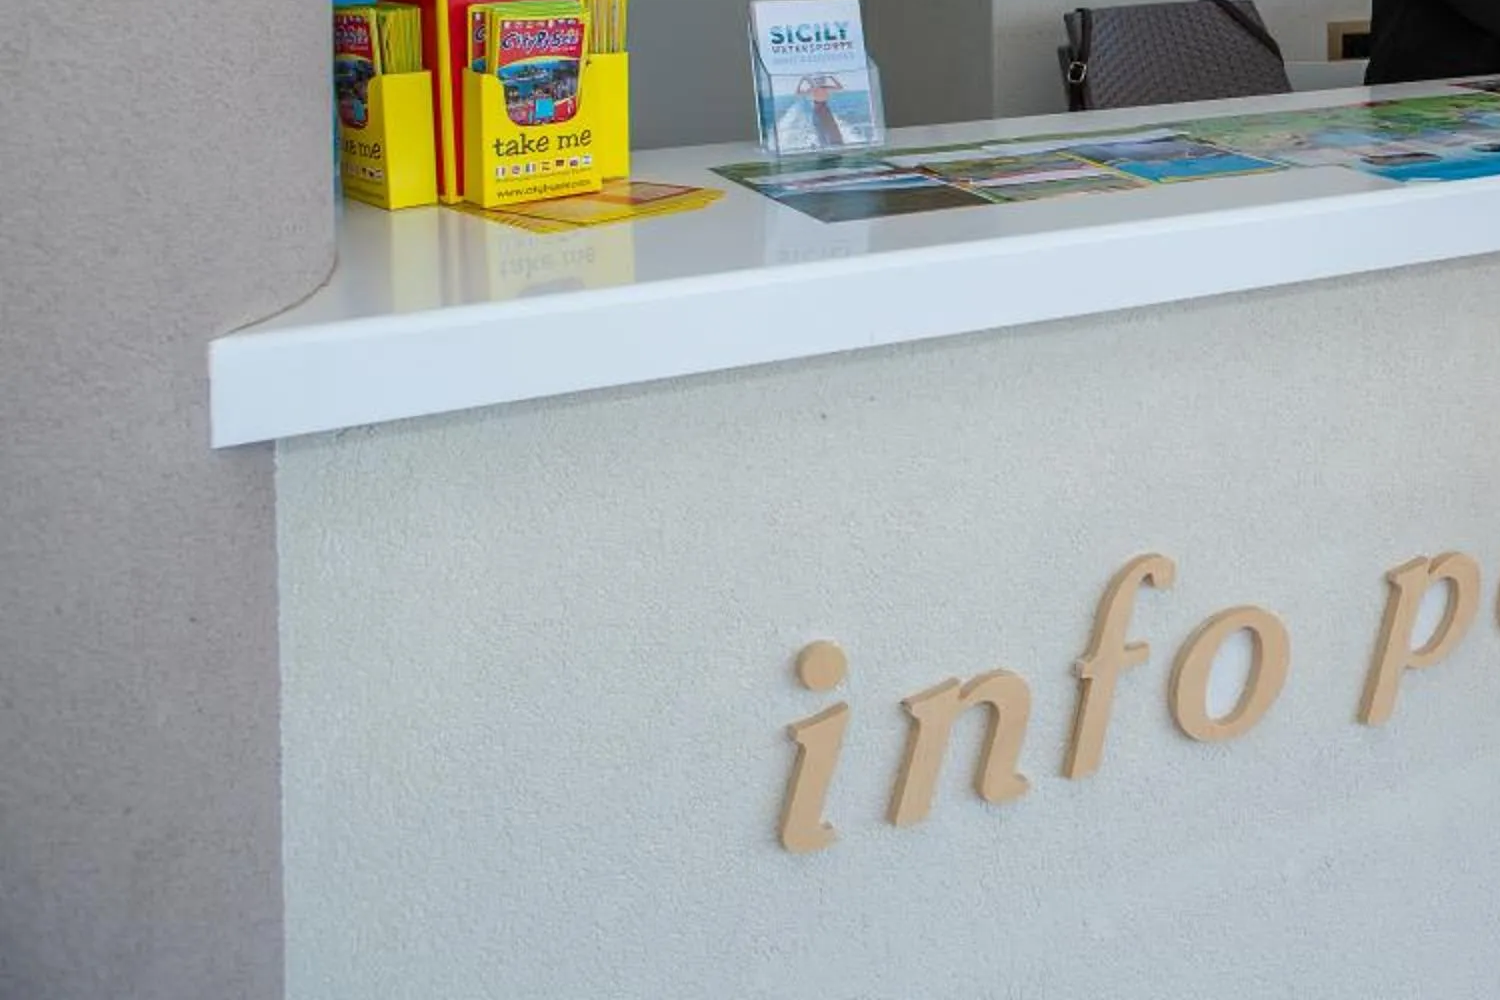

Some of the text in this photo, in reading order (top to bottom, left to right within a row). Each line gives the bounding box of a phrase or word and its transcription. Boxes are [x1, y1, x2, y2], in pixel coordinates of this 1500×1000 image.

[770, 21, 850, 45] SICILY
[492, 128, 593, 157] take me
[776, 551, 1292, 854] info
